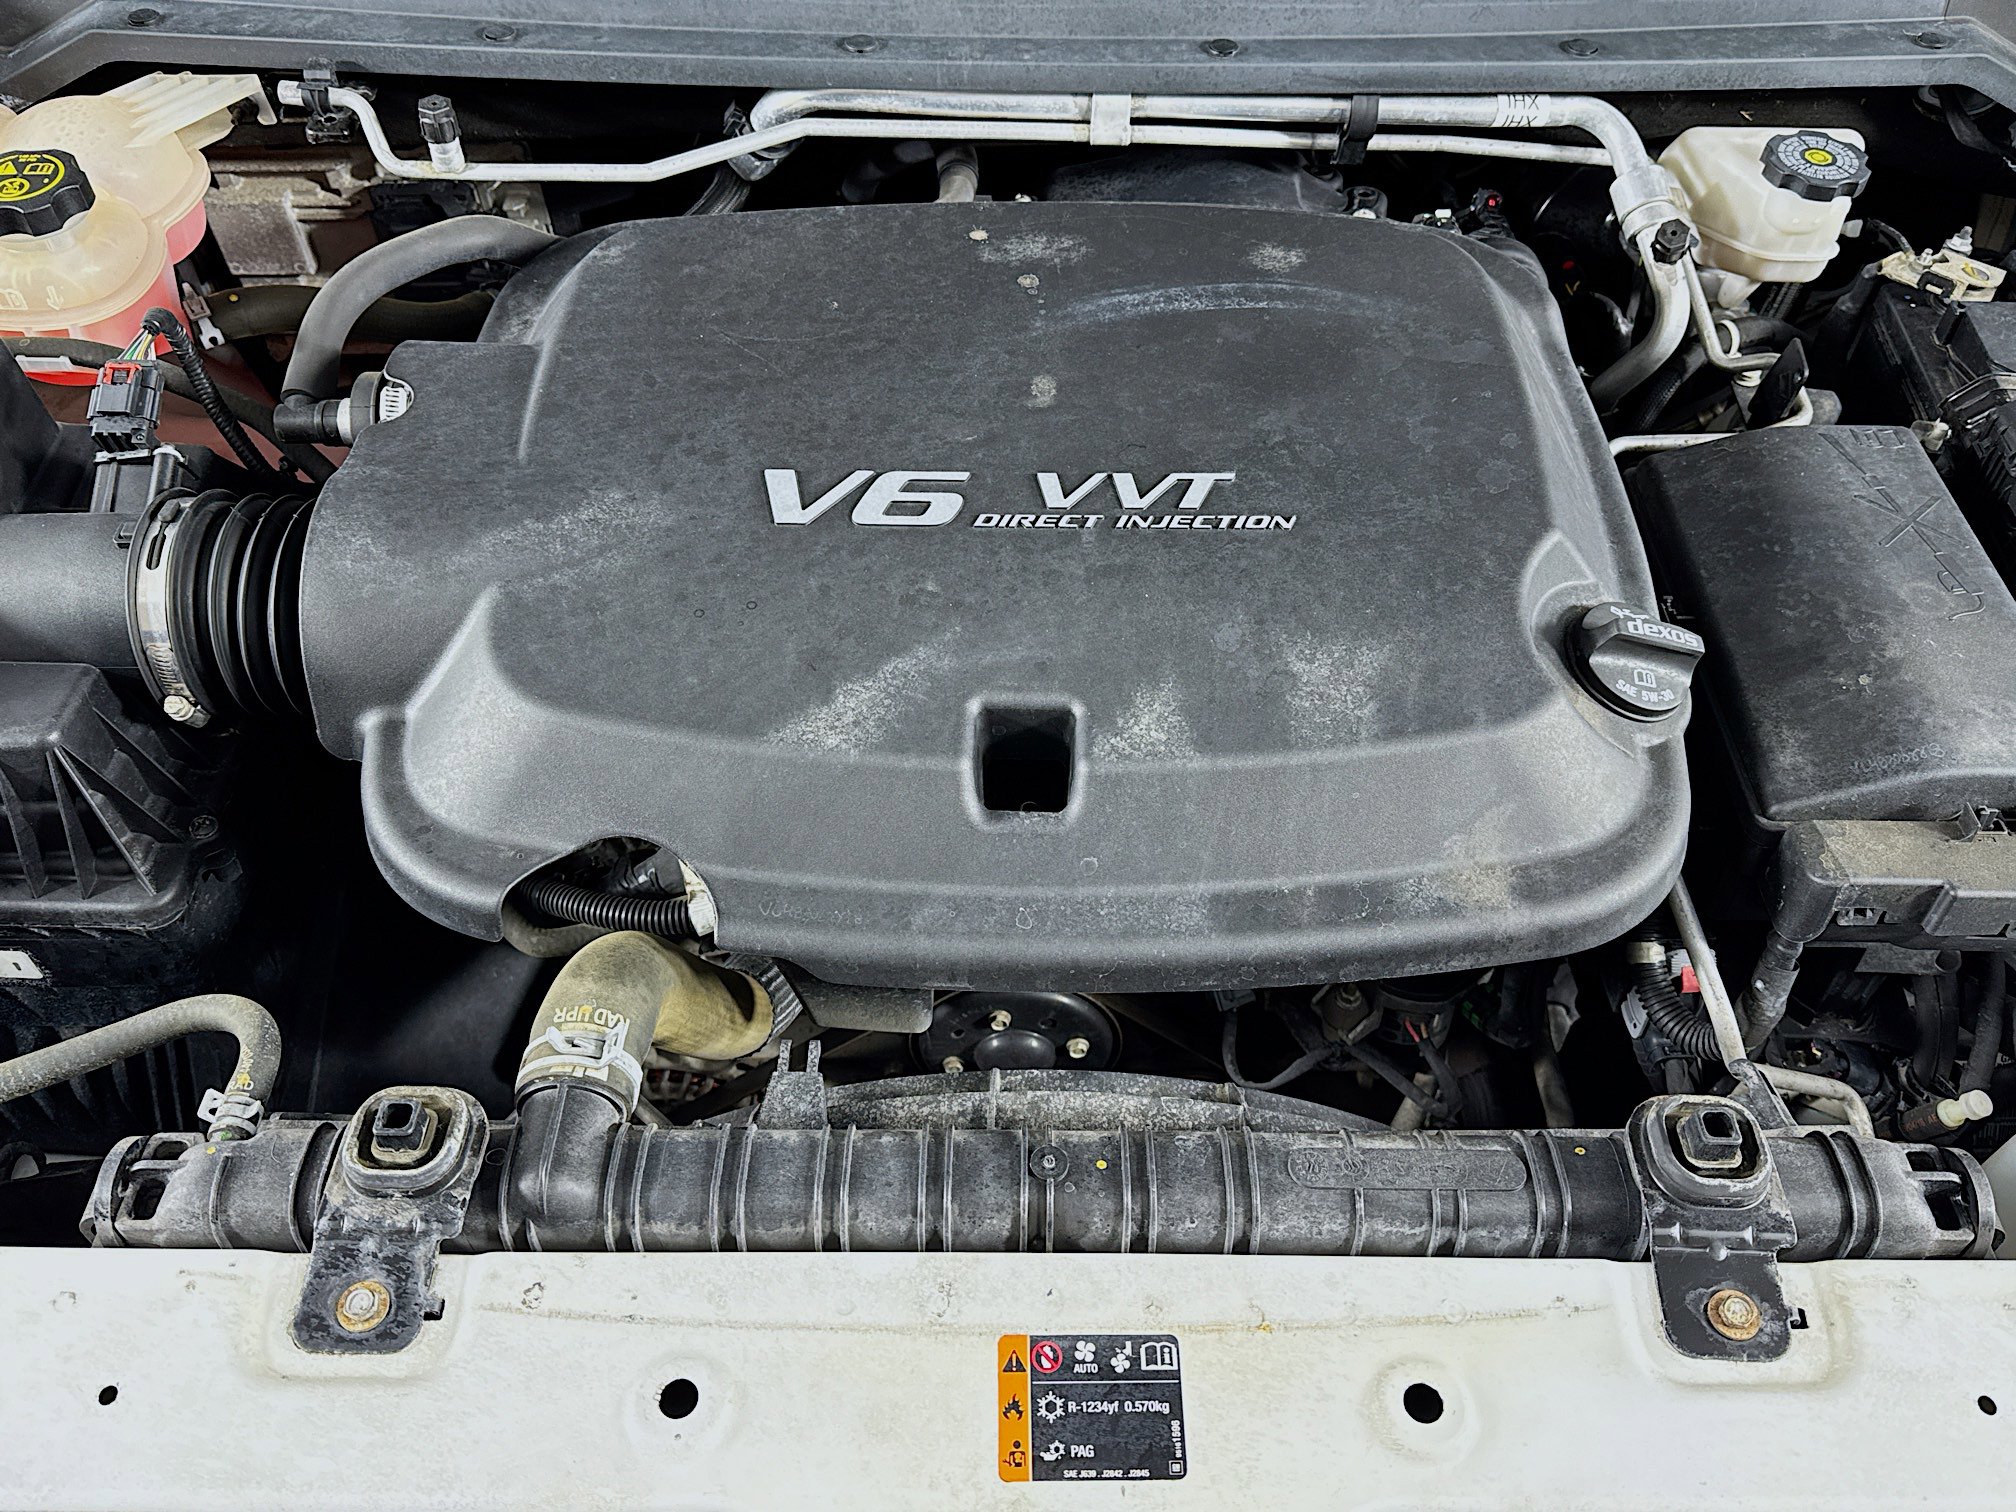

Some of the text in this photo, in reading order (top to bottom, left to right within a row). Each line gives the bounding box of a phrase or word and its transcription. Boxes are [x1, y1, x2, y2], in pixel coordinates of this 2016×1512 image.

[764, 468, 971, 527] V6
[1036, 472, 1236, 510] VVT
[973, 513, 1298, 531] DIRECT INJECTION
[1627, 618, 1699, 647] dexos
[1615, 679, 1675, 703] SAE 5W-30
[1073, 1363, 1098, 1374] AUTO
[1067, 1401, 1170, 1415] R-1234yf 0.570kg
[1070, 1445, 1095, 1458] PAG
[1063, 1469, 1078, 1478] SAE
